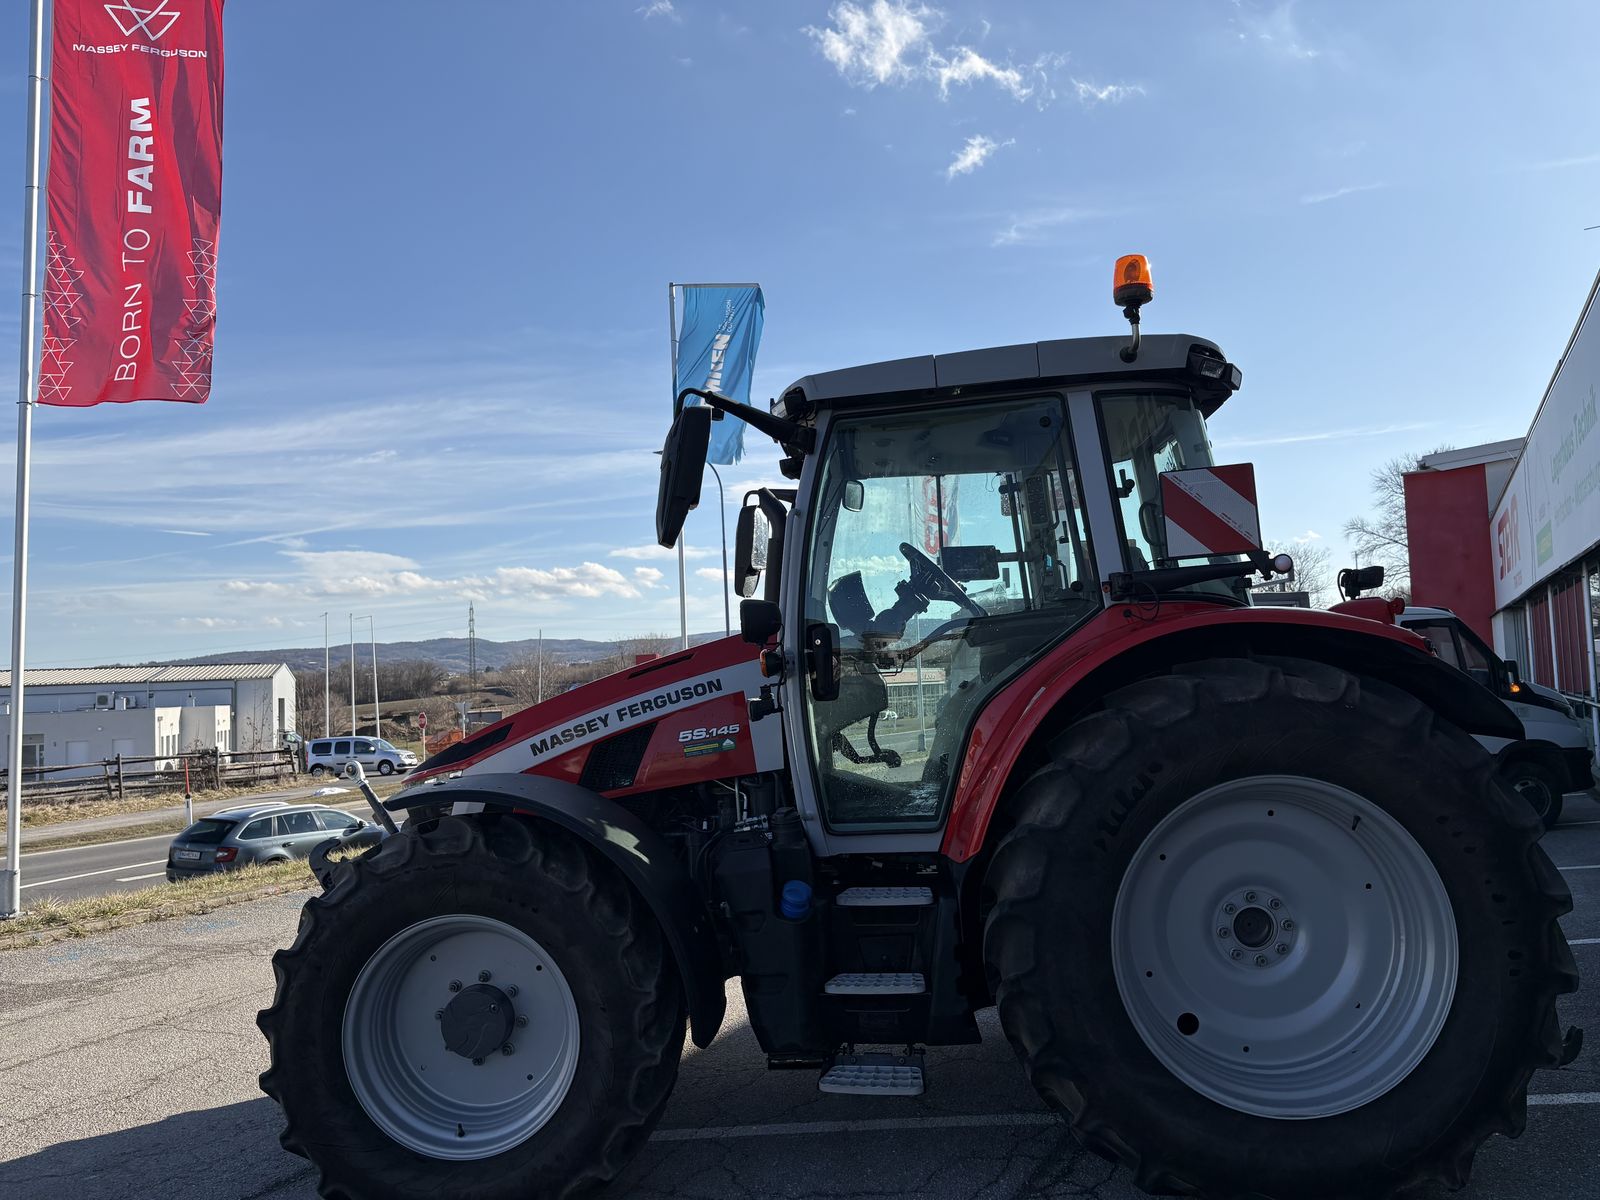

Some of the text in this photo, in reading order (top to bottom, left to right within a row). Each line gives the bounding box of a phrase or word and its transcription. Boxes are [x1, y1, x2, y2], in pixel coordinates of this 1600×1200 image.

[72, 43, 208, 58] MASSEY FERGUSON
[113, 96, 155, 382] BORN TO FARM
[1497, 493, 1521, 581] STEYR
[529, 678, 723, 757] MASSEY FERGUSON
[678, 724, 740, 742] 5S.145
